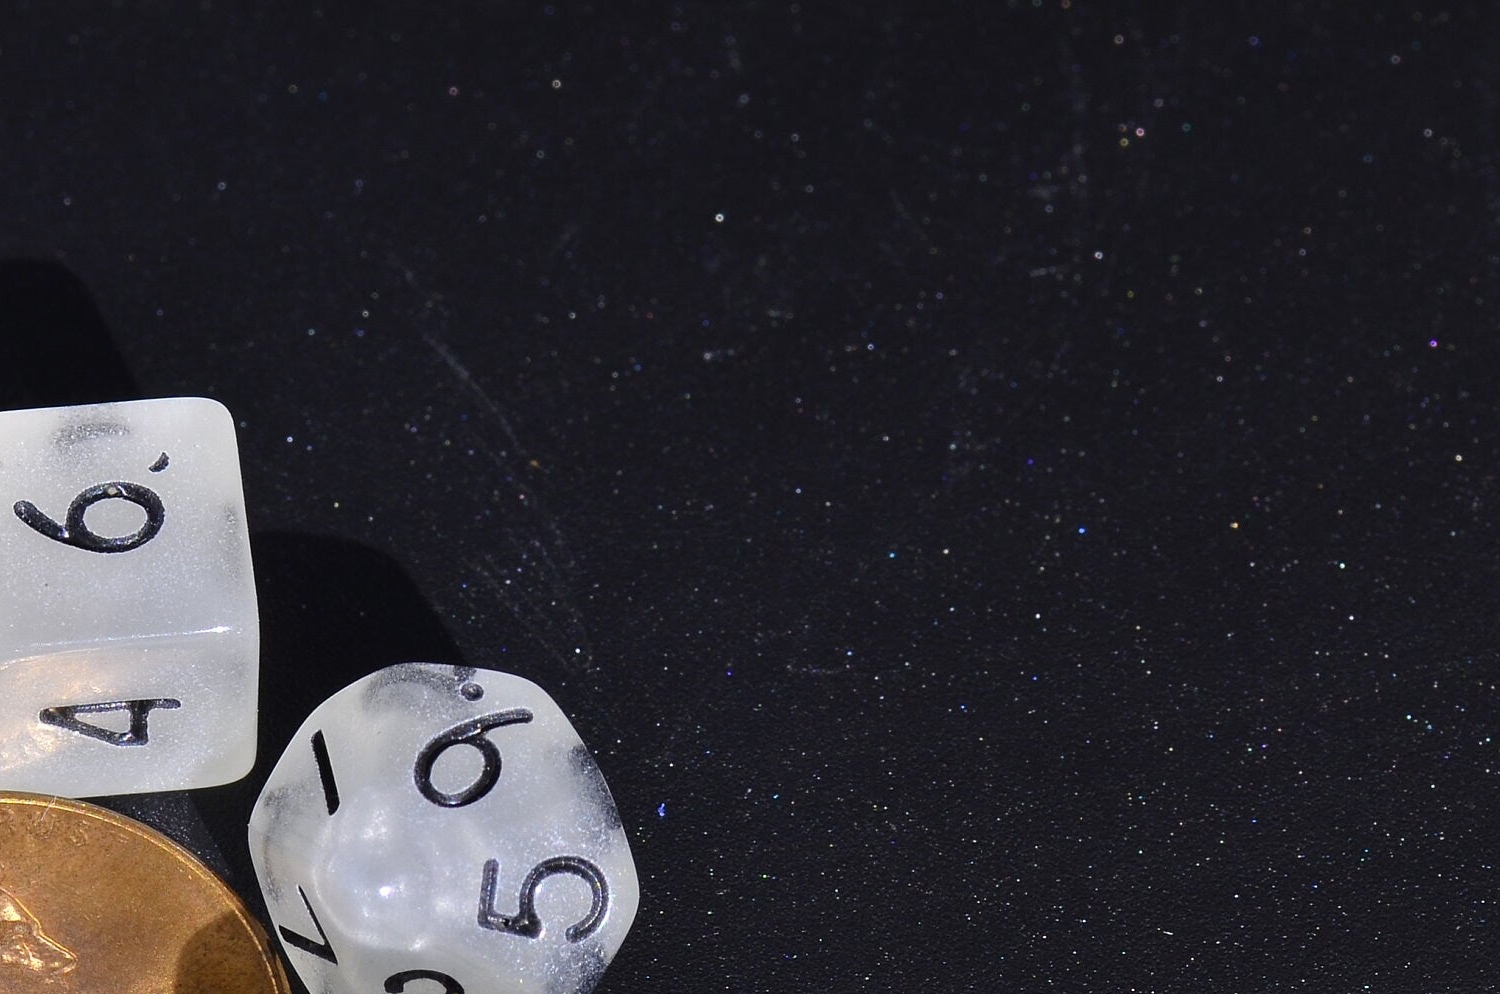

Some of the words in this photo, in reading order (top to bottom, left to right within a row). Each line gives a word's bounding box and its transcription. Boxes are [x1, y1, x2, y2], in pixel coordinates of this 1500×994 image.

[39, 699, 182, 746] 4
[312, 729, 340, 816] 1
[478, 856, 610, 943] 5
